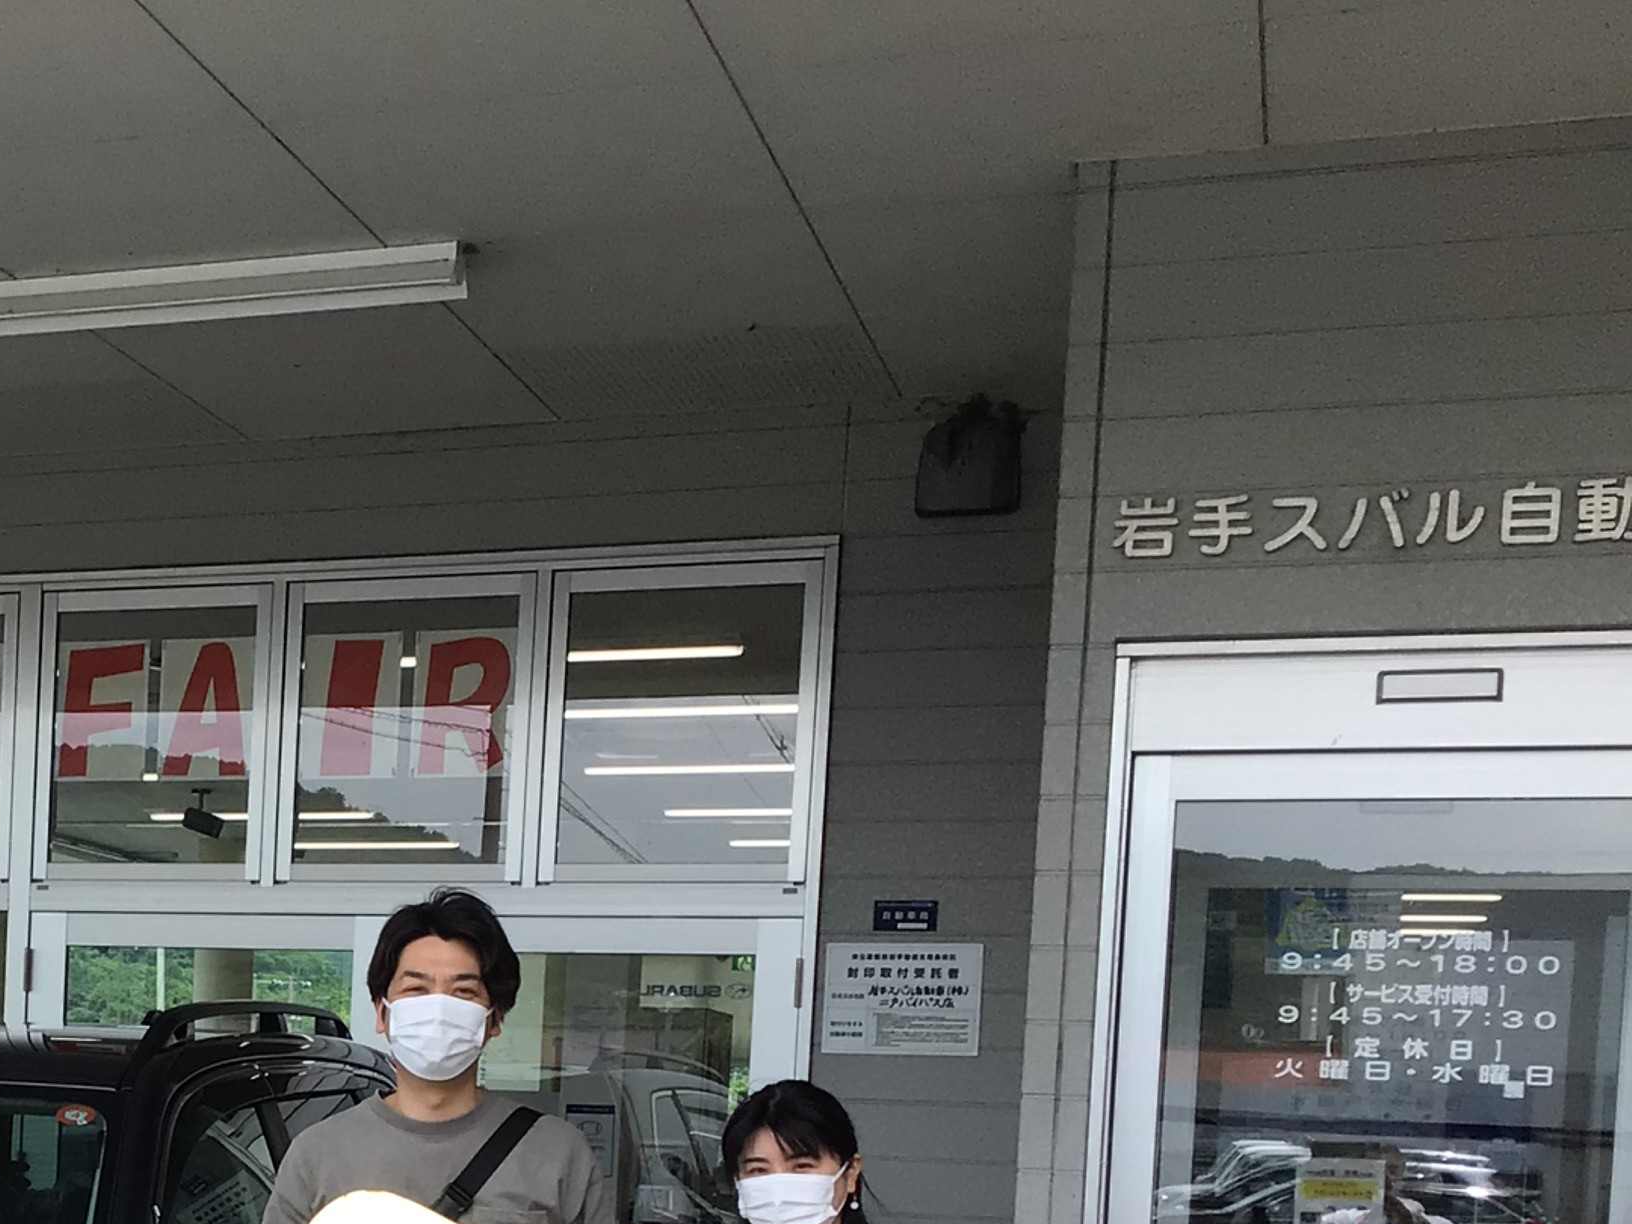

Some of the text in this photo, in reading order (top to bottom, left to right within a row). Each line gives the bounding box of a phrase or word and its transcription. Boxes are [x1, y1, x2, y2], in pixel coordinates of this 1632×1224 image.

[1112, 476, 1632, 558] 岩手スバル自動
[57, 635, 513, 778] FAIR
